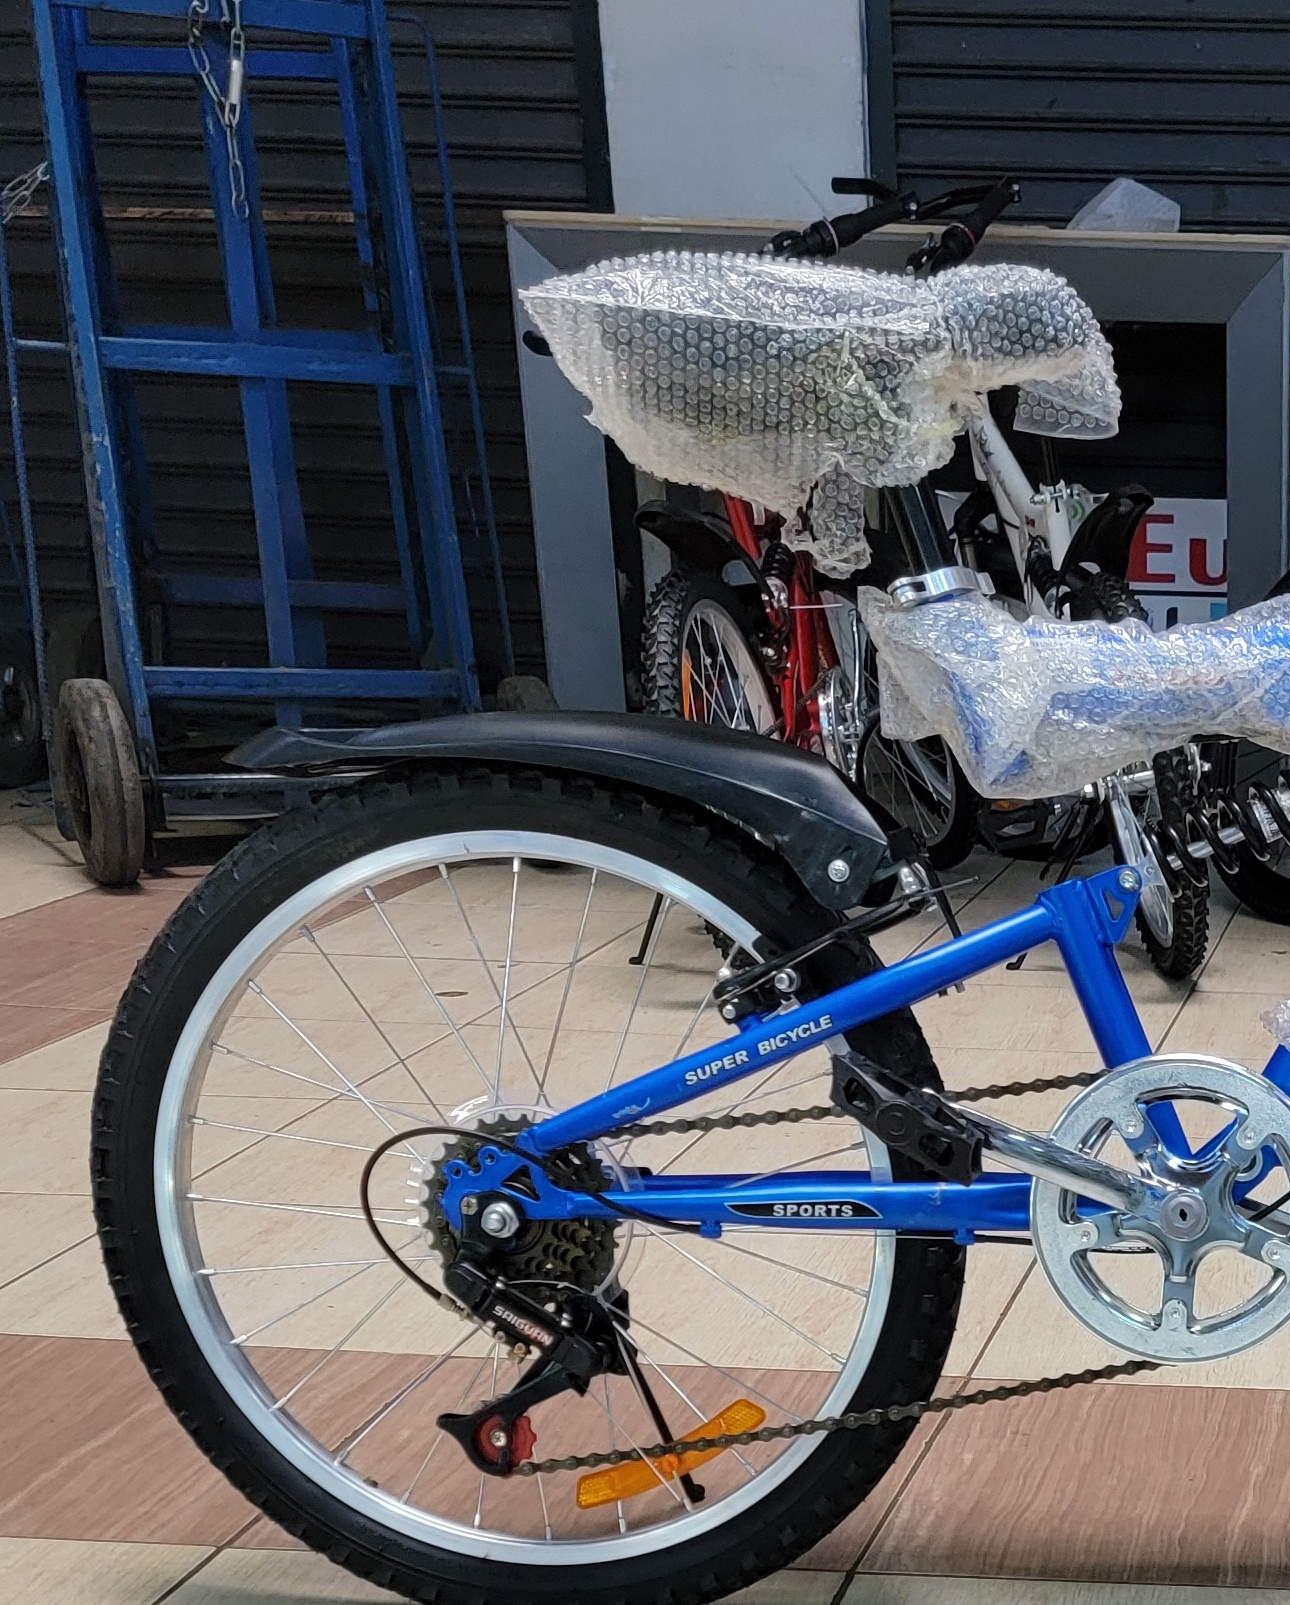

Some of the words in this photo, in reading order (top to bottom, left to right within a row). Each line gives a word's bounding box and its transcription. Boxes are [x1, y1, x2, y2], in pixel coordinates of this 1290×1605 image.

[684, 1049, 750, 1086] SUPER
[757, 1014, 833, 1057] BICYCLE
[772, 1204, 854, 1217] SPORTS
